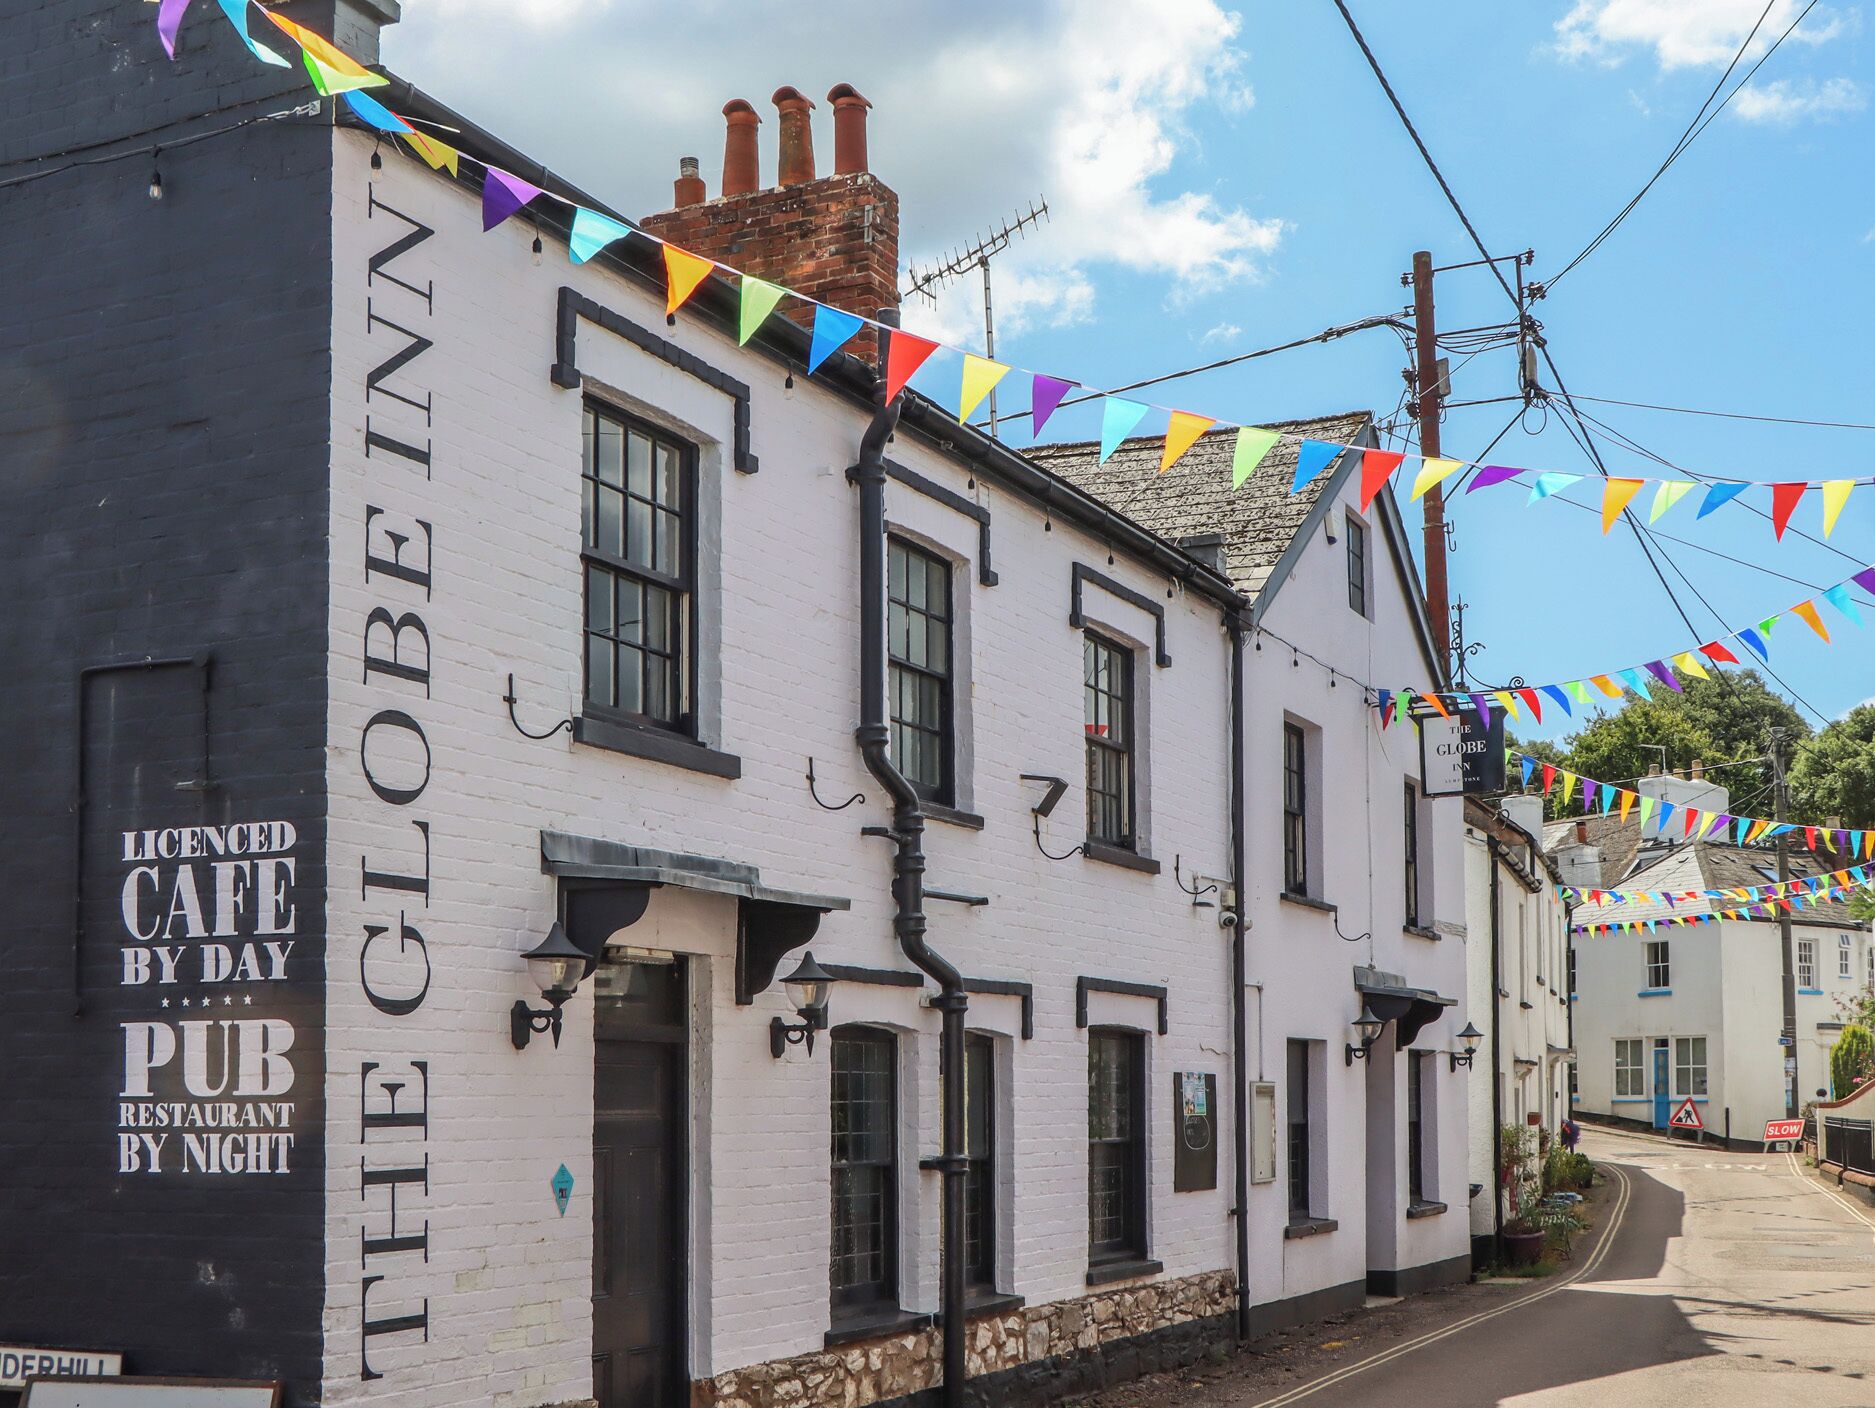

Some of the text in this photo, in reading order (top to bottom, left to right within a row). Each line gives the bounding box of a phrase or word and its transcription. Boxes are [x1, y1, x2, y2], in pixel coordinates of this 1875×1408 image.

[1436, 740, 1487, 756] GLOBE
[1449, 724, 1472, 734] THE
[360, 182, 435, 1381] THE GLOBE INN
[1452, 761, 1470, 771] INN
[121, 820, 297, 862] LICENCED
[121, 856, 296, 941] CAFE
[120, 941, 296, 985] BY DAY
[119, 1018, 296, 1097] PUB
[118, 1102, 295, 1128] RESTAURANT
[1767, 1125, 1800, 1136] SLOW
[118, 1132, 295, 1174] BY NIGHT
